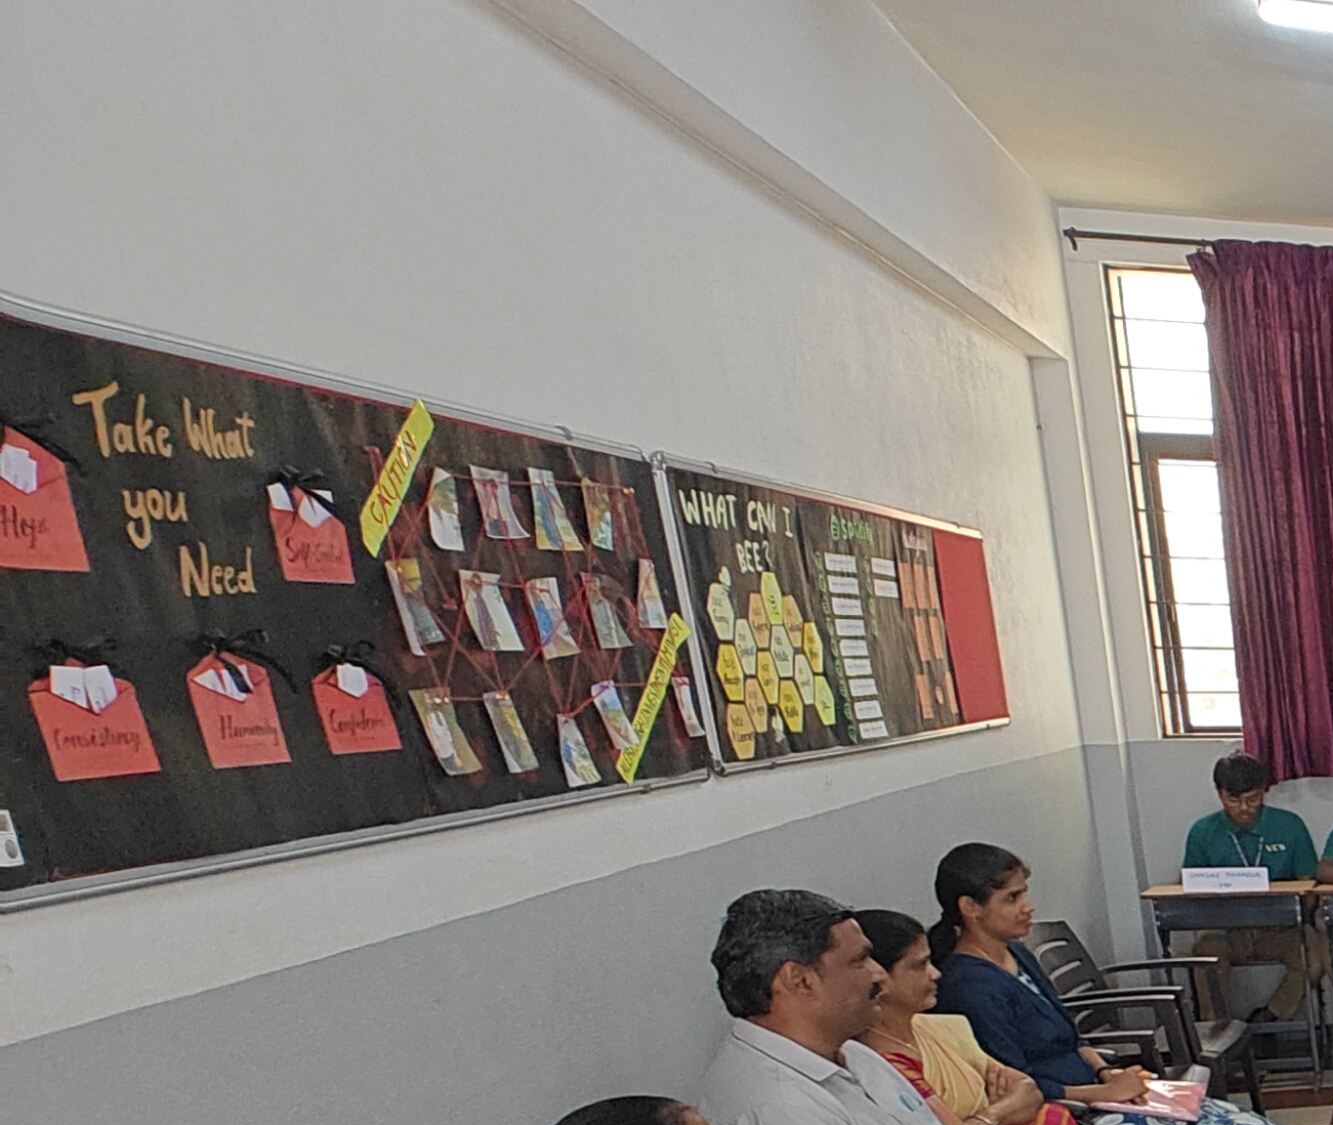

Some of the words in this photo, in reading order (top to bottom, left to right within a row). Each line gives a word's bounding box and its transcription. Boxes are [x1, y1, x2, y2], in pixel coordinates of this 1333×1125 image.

[72, 381, 173, 458] Take
[182, 397, 255, 459] What
[370, 430, 417, 525] CAUTION
[122, 488, 189, 550] you
[678, 489, 737, 531] WHAT
[747, 500, 778, 534] CAN
[782, 506, 793, 538] I
[179, 541, 258, 597] Need
[735, 540, 773, 574] BEE?
